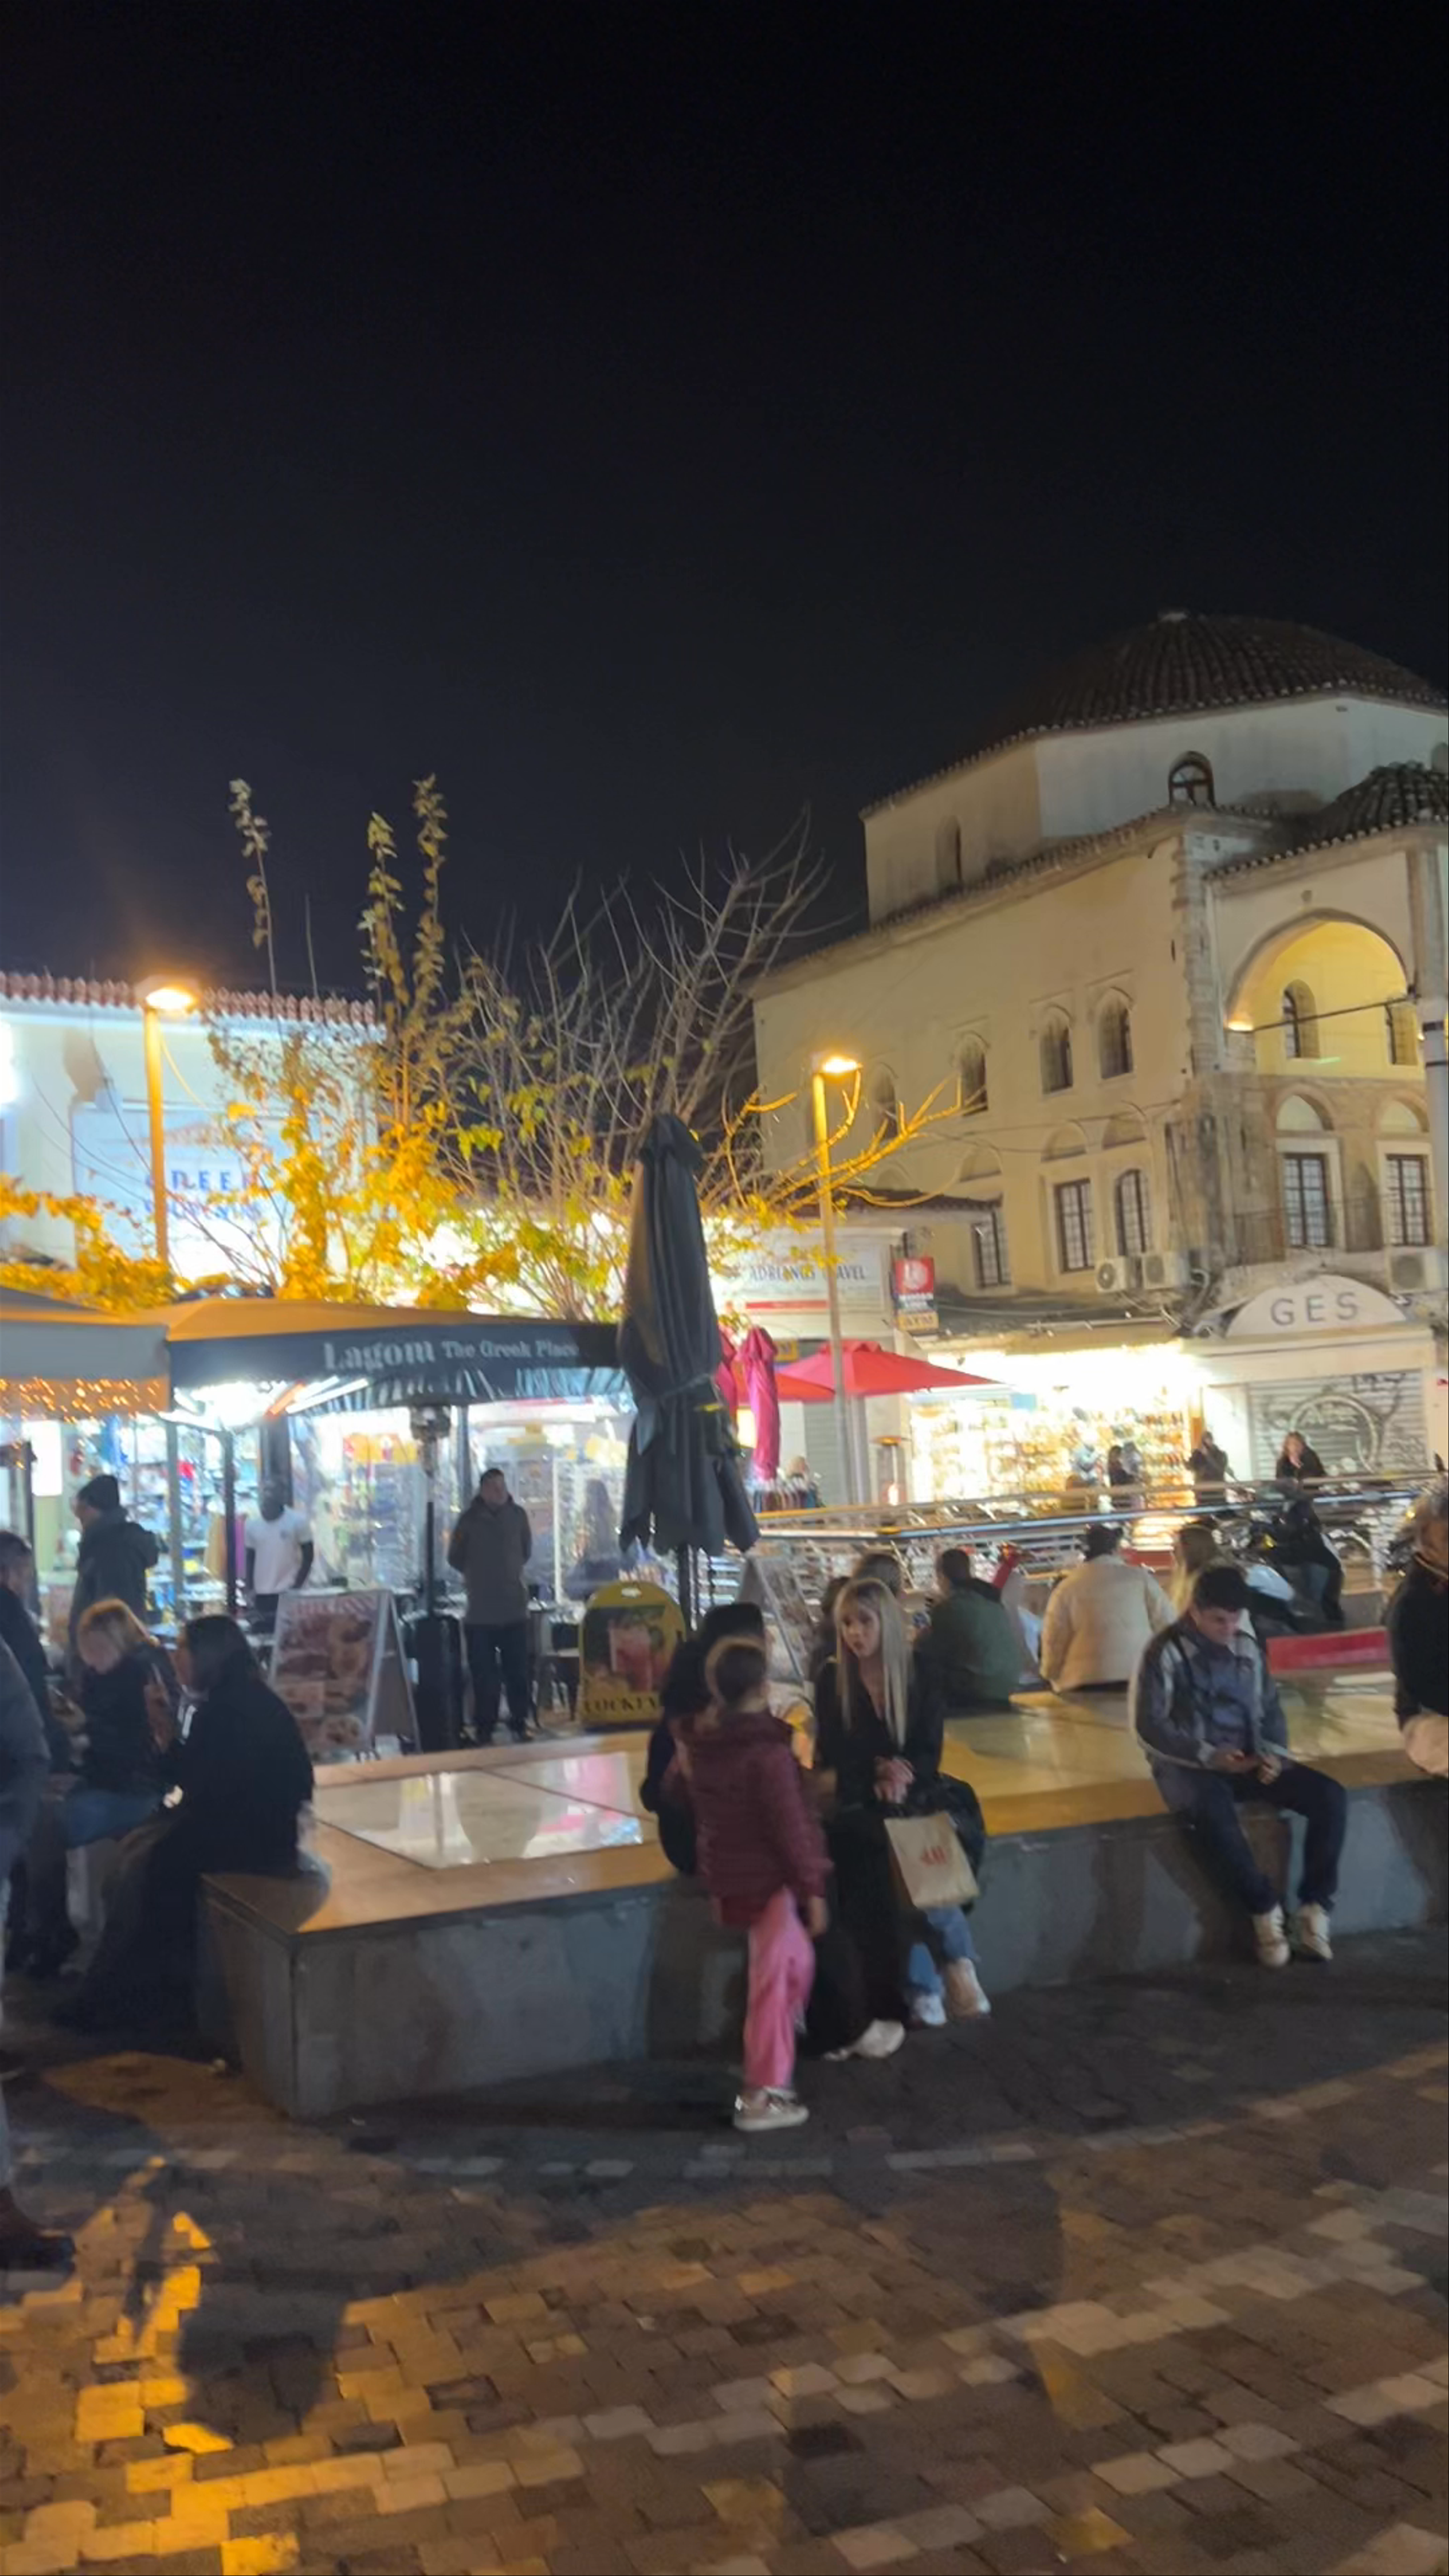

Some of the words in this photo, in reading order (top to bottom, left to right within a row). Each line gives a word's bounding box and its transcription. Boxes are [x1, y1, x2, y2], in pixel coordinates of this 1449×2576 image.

[1270, 1292, 1359, 1326] GES
[324, 1340, 435, 1372] Lagom
[441, 1341, 476, 1358] The
[480, 1340, 531, 1358] Greek
